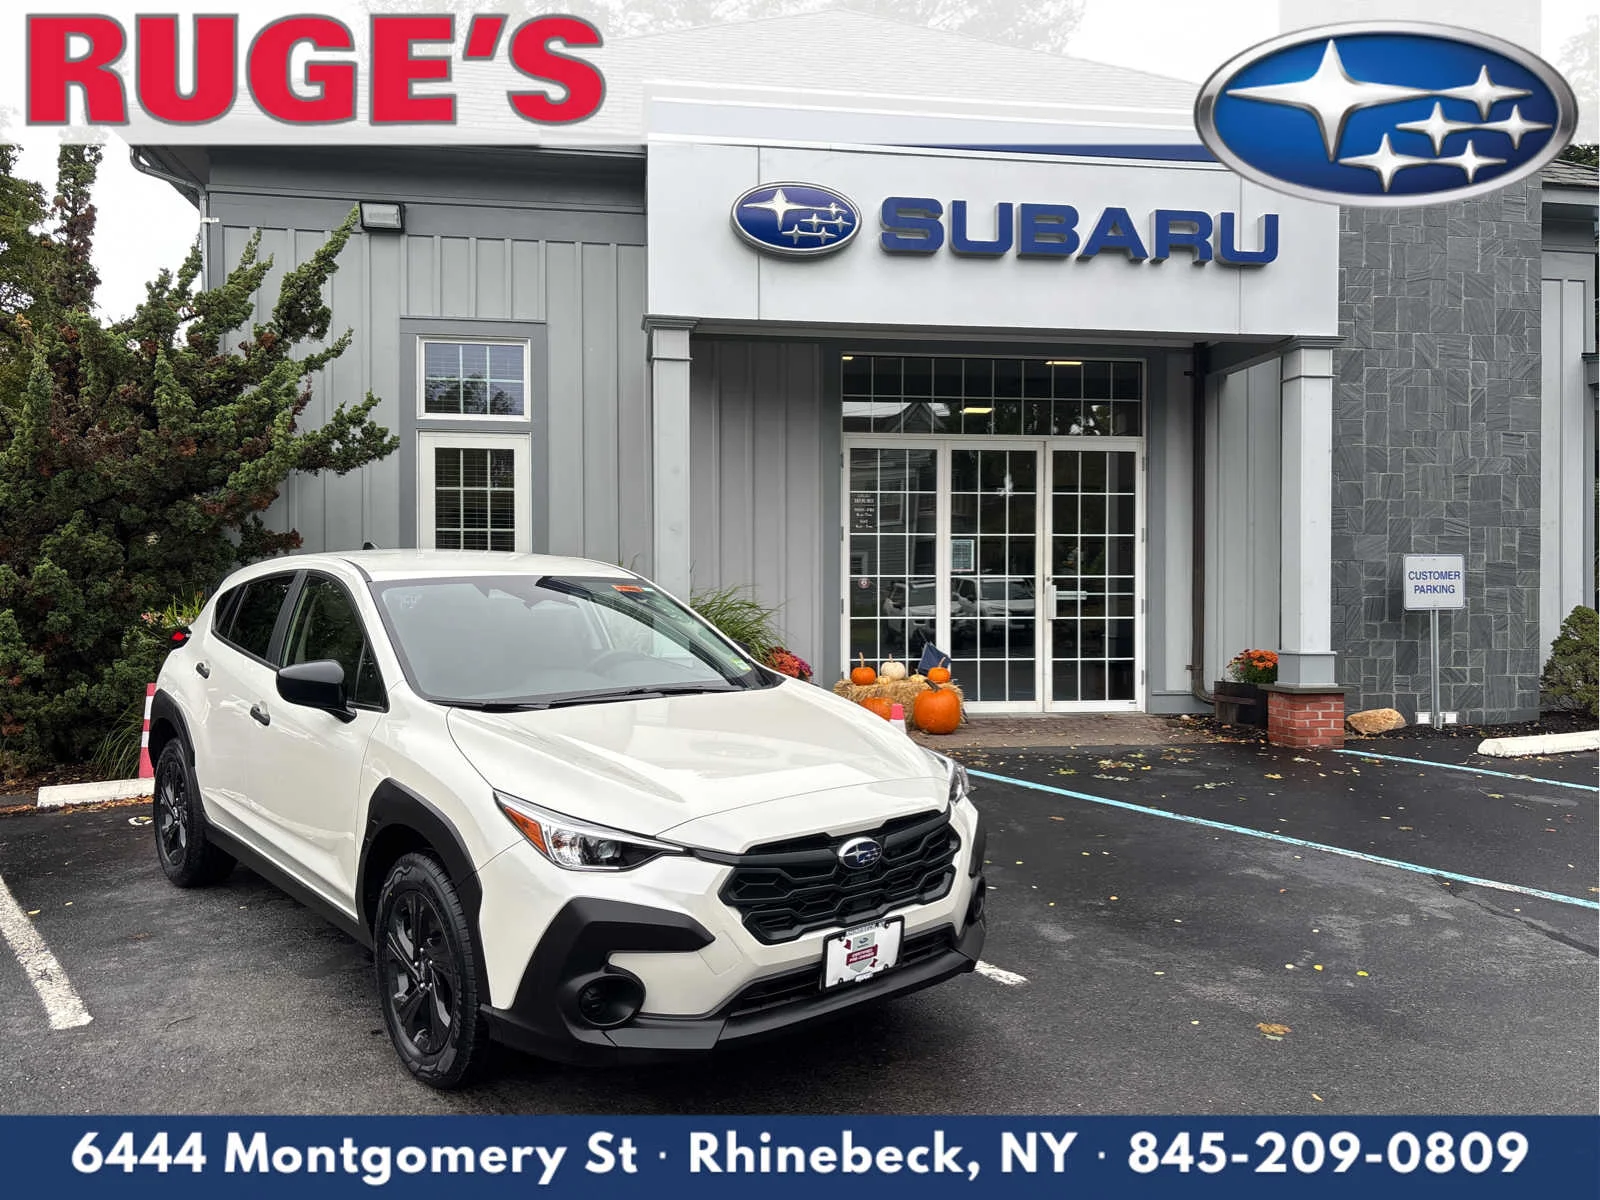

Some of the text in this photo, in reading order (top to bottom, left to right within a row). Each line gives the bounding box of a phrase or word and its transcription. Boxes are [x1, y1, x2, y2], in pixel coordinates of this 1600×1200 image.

[880, 196, 1279, 267] SUBARU
[1408, 570, 1461, 581] CUSTOMER
[1413, 584, 1456, 594] PARKING
